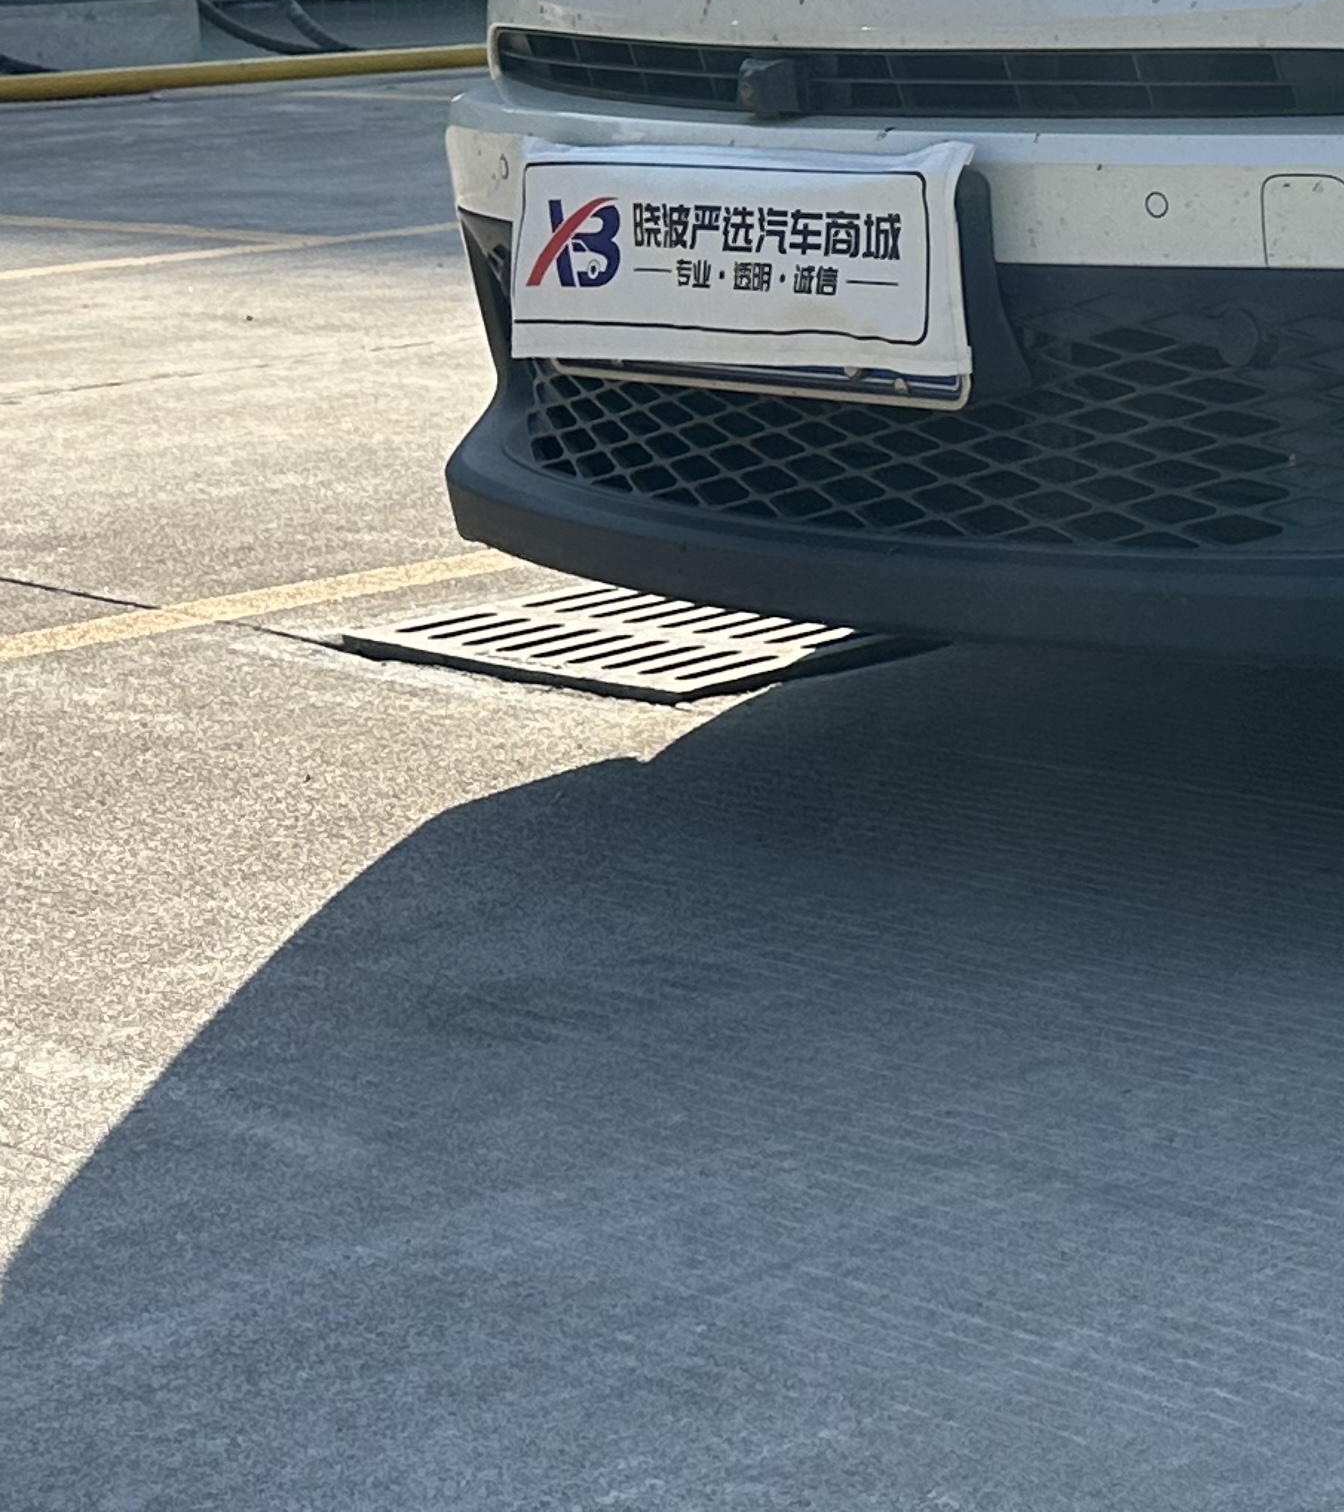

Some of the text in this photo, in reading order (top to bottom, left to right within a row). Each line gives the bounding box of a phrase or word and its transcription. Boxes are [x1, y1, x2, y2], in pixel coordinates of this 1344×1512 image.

[632, 202, 901, 261] 晓波严选汽车商城
